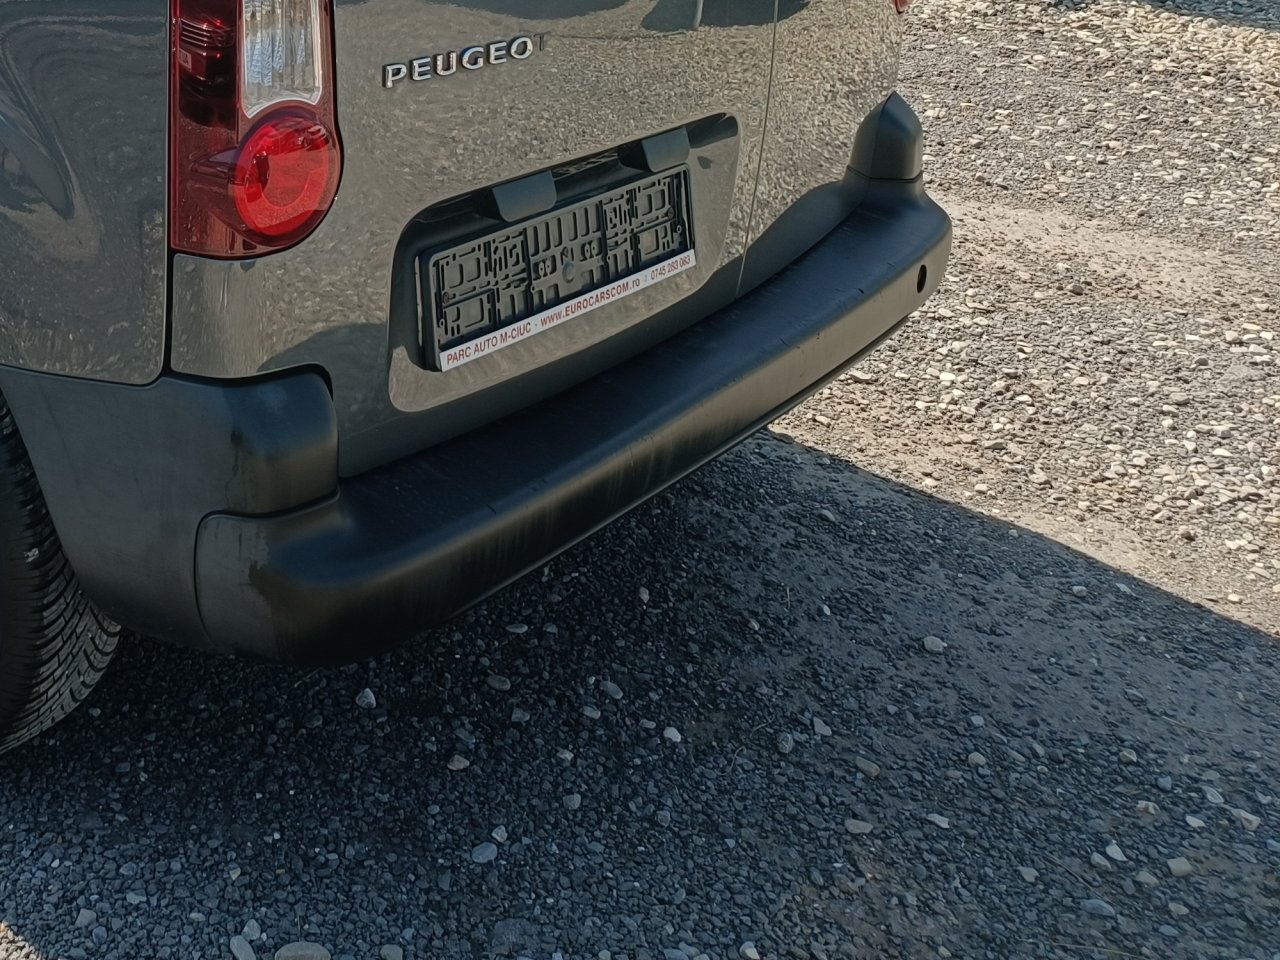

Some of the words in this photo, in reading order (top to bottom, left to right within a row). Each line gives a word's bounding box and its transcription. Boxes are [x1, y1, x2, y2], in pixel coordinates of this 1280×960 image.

[382, 31, 550, 89] PEUGEOT
[447, 347, 472, 365] PARC
[473, 336, 498, 354] AUTO
[500, 322, 531, 343] M-CIUC
[540, 278, 640, 327] www.EUROCARSCOM.ro
